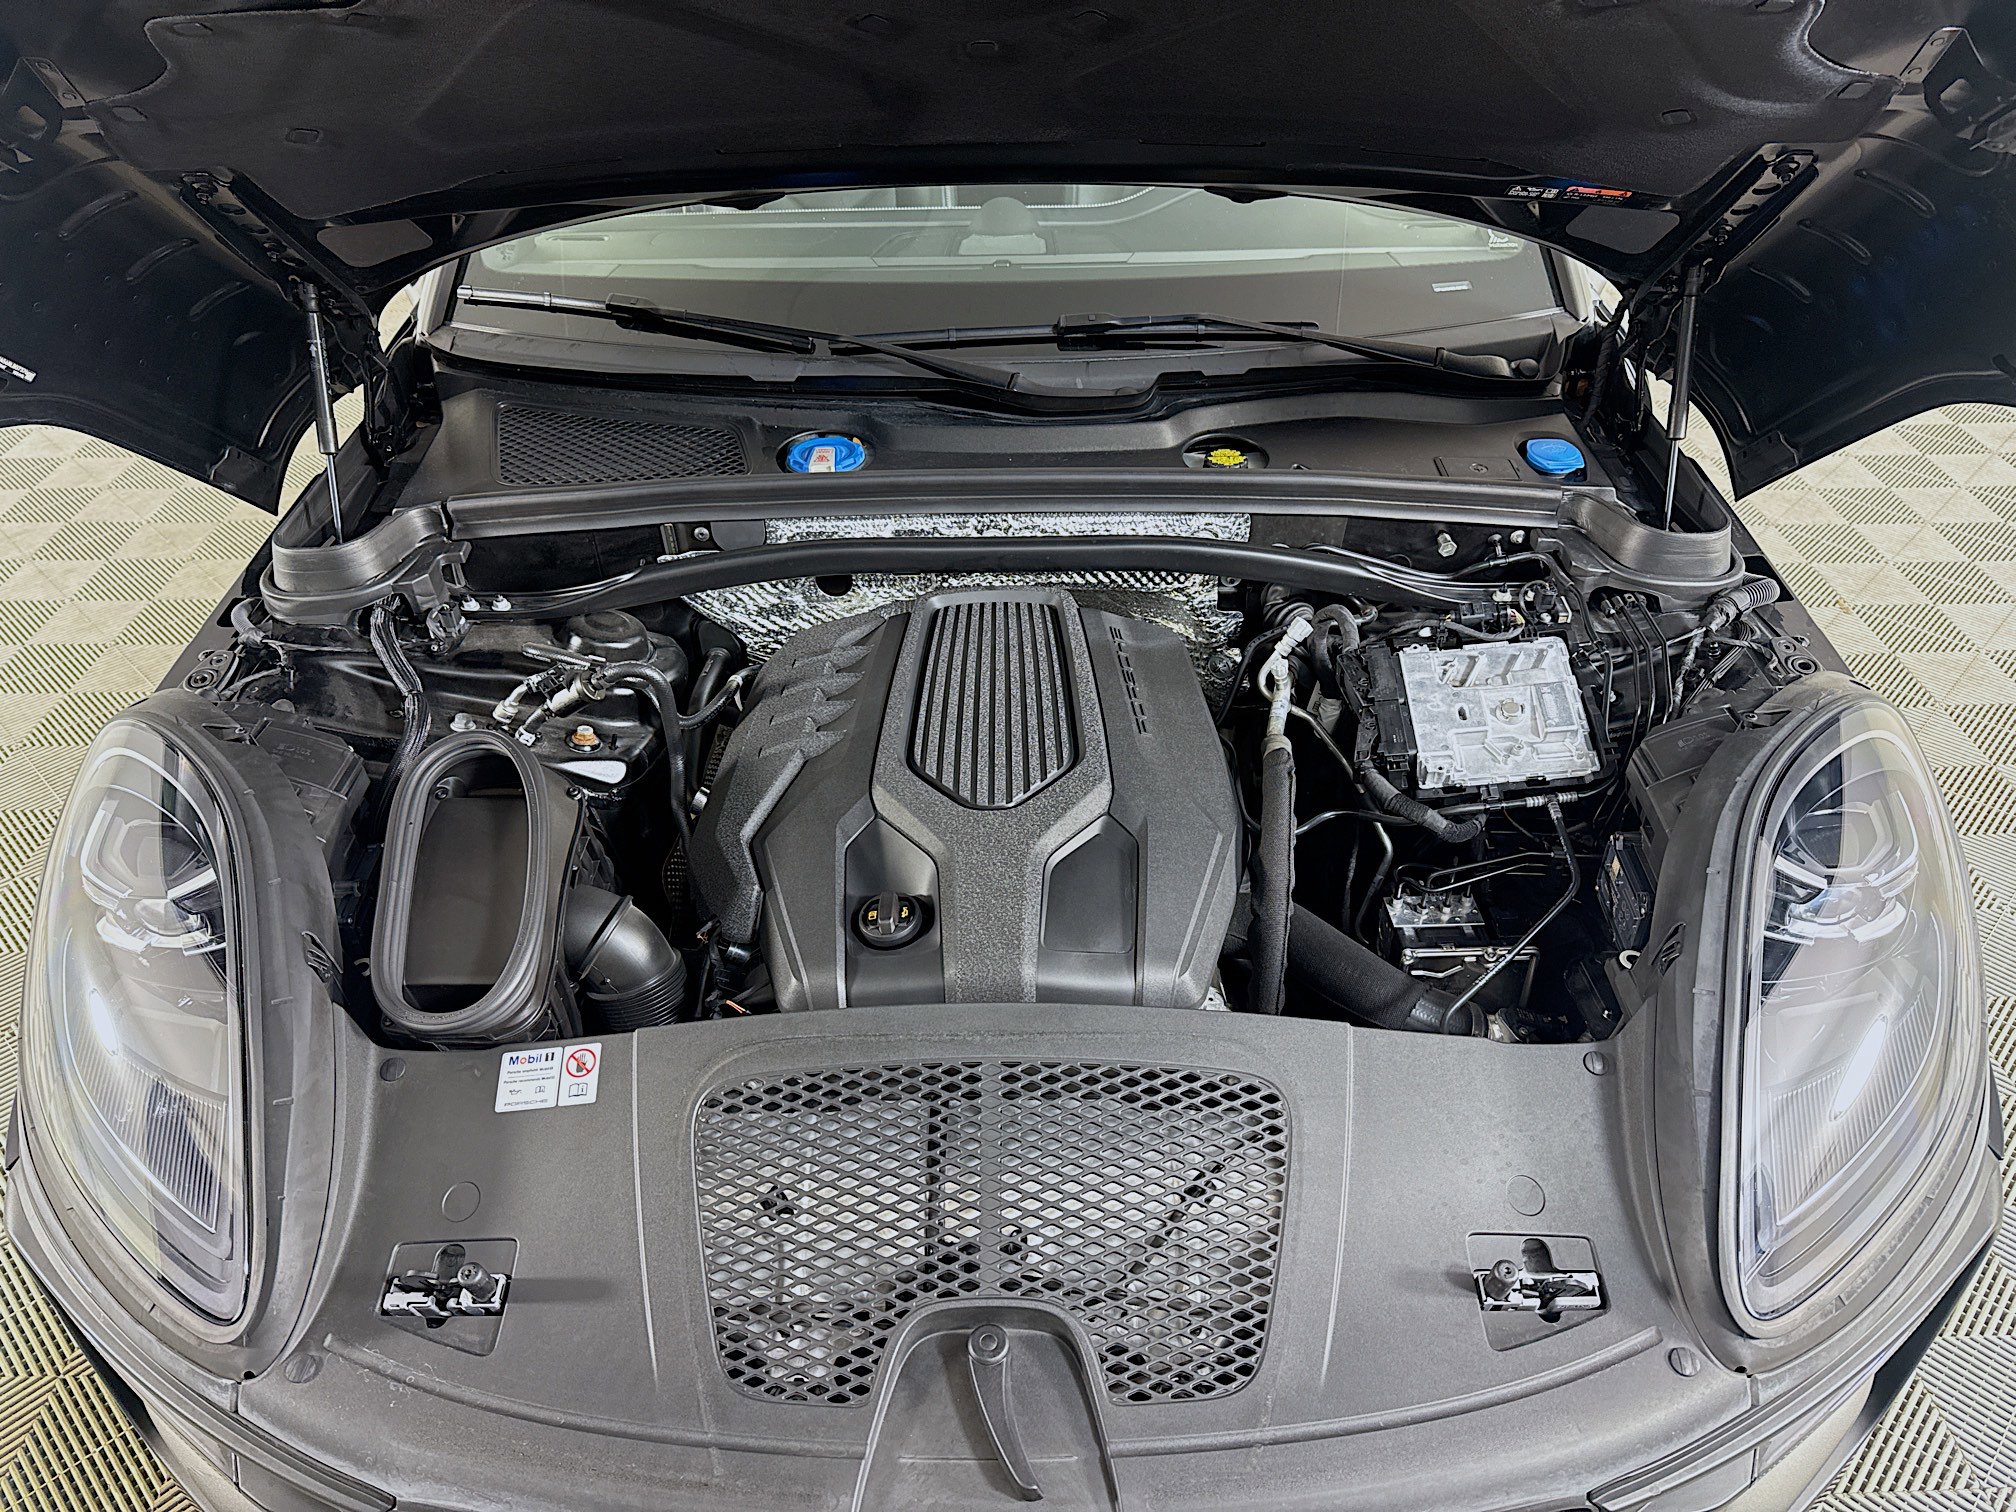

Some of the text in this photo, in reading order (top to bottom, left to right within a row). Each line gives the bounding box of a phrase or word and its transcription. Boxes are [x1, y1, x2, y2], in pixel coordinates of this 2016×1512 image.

[1109, 626, 1151, 736] PORSCHE
[508, 1052, 555, 1066] Mobil 1
[504, 1099, 548, 1107] PORSCHE
